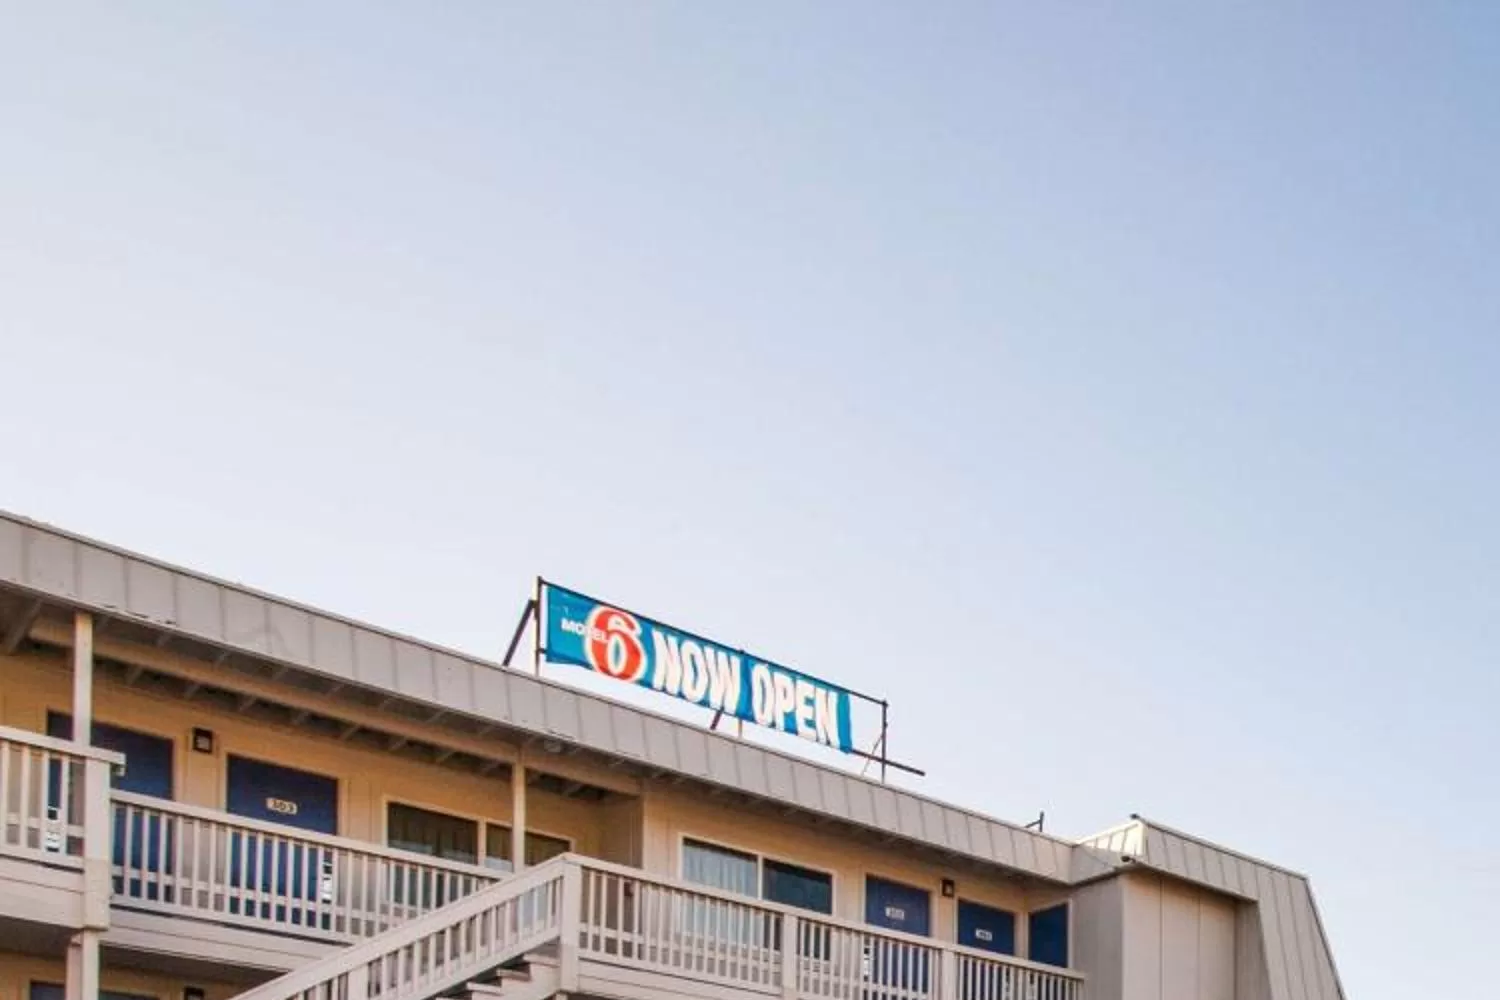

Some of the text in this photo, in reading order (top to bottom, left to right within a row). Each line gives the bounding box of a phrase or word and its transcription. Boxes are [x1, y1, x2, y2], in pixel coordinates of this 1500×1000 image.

[586, 605, 841, 750] 6 NOW OPEN
